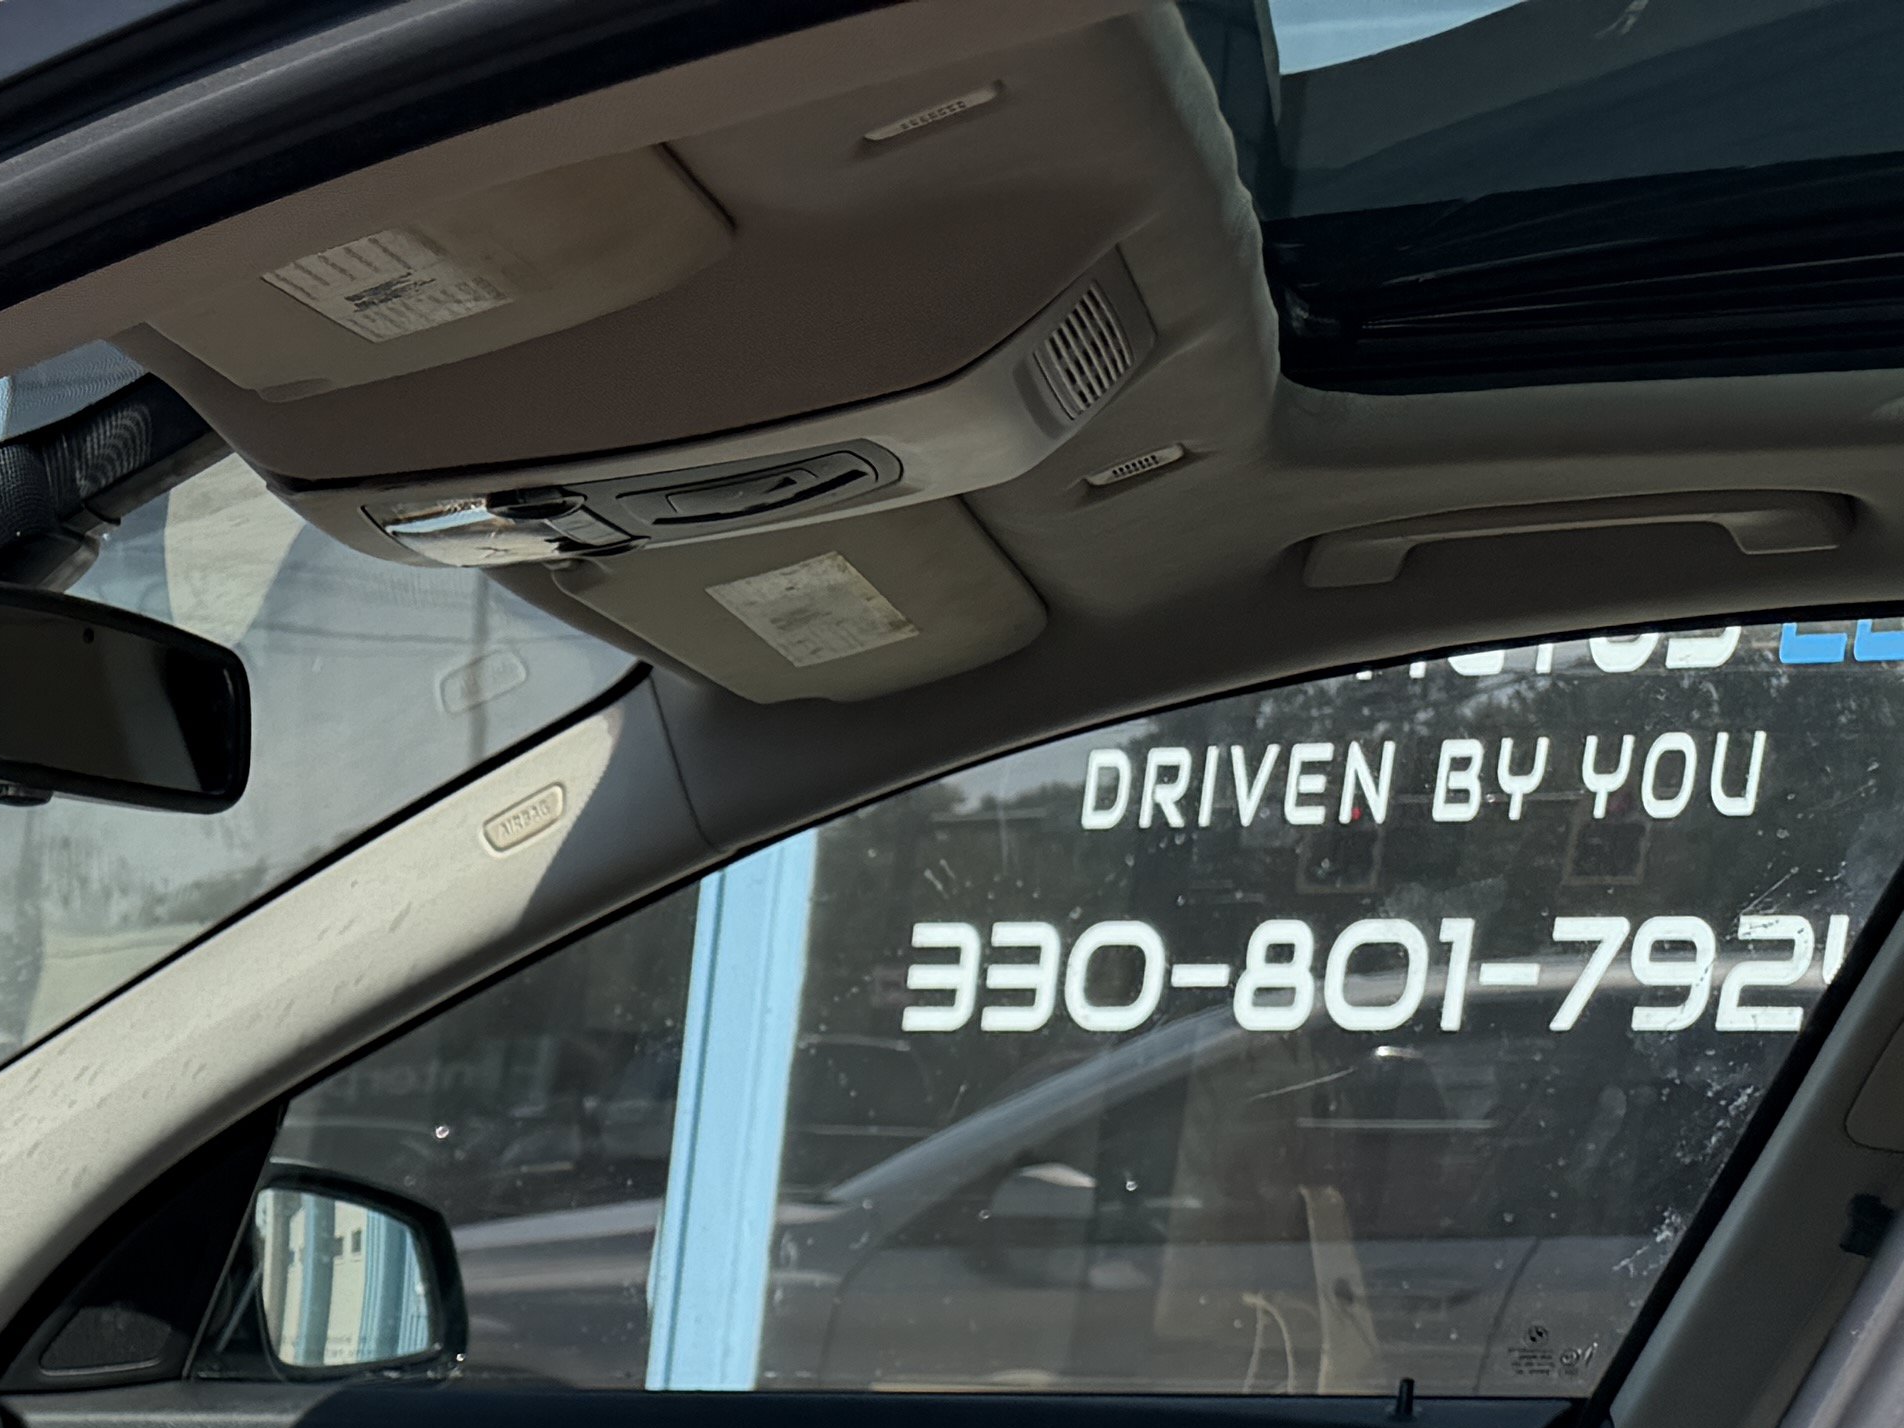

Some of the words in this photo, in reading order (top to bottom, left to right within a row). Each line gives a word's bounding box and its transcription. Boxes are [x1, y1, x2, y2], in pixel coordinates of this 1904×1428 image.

[1081, 741, 1395, 830] DRIVEN
[1432, 737, 1550, 824] BY
[1582, 731, 1767, 819] YOU
